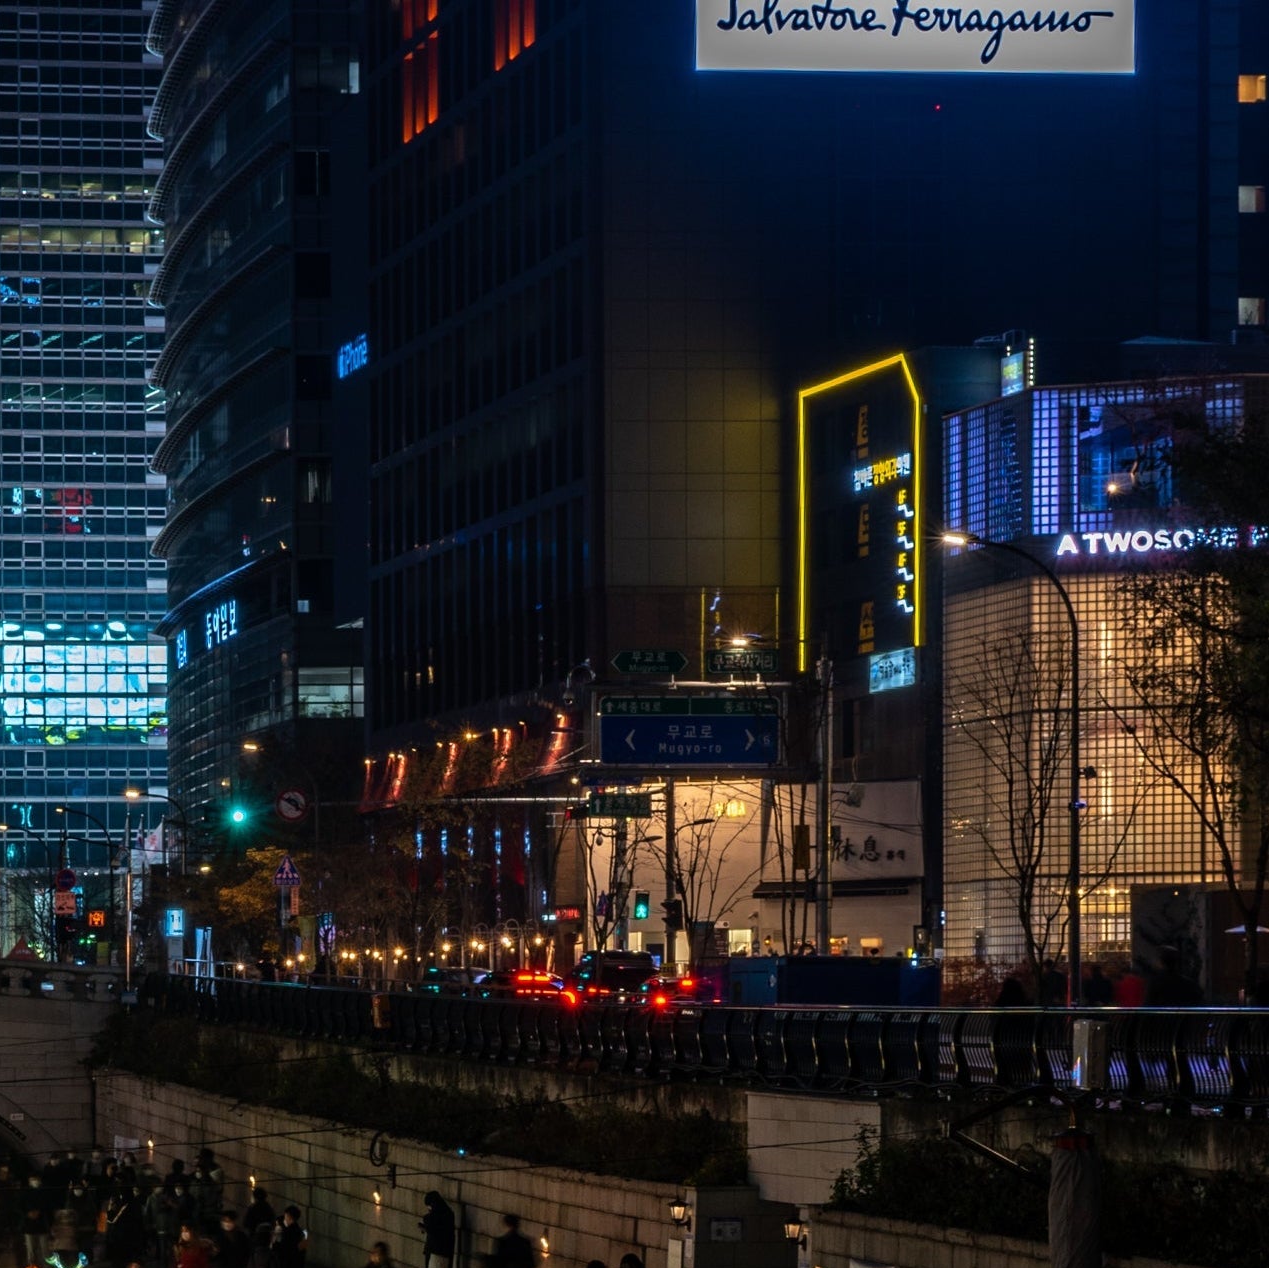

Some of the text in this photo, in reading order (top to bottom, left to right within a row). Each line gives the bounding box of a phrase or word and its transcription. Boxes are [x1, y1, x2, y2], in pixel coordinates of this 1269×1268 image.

[1057, 534, 1078, 555] A
[206, 600, 237, 650] 동아일보
[630, 651, 667, 663] 무교로
[617, 701, 662, 713] 세종대로
[668, 724, 714, 740] 무교로
[658, 743, 723, 756] Mugyo-ro
